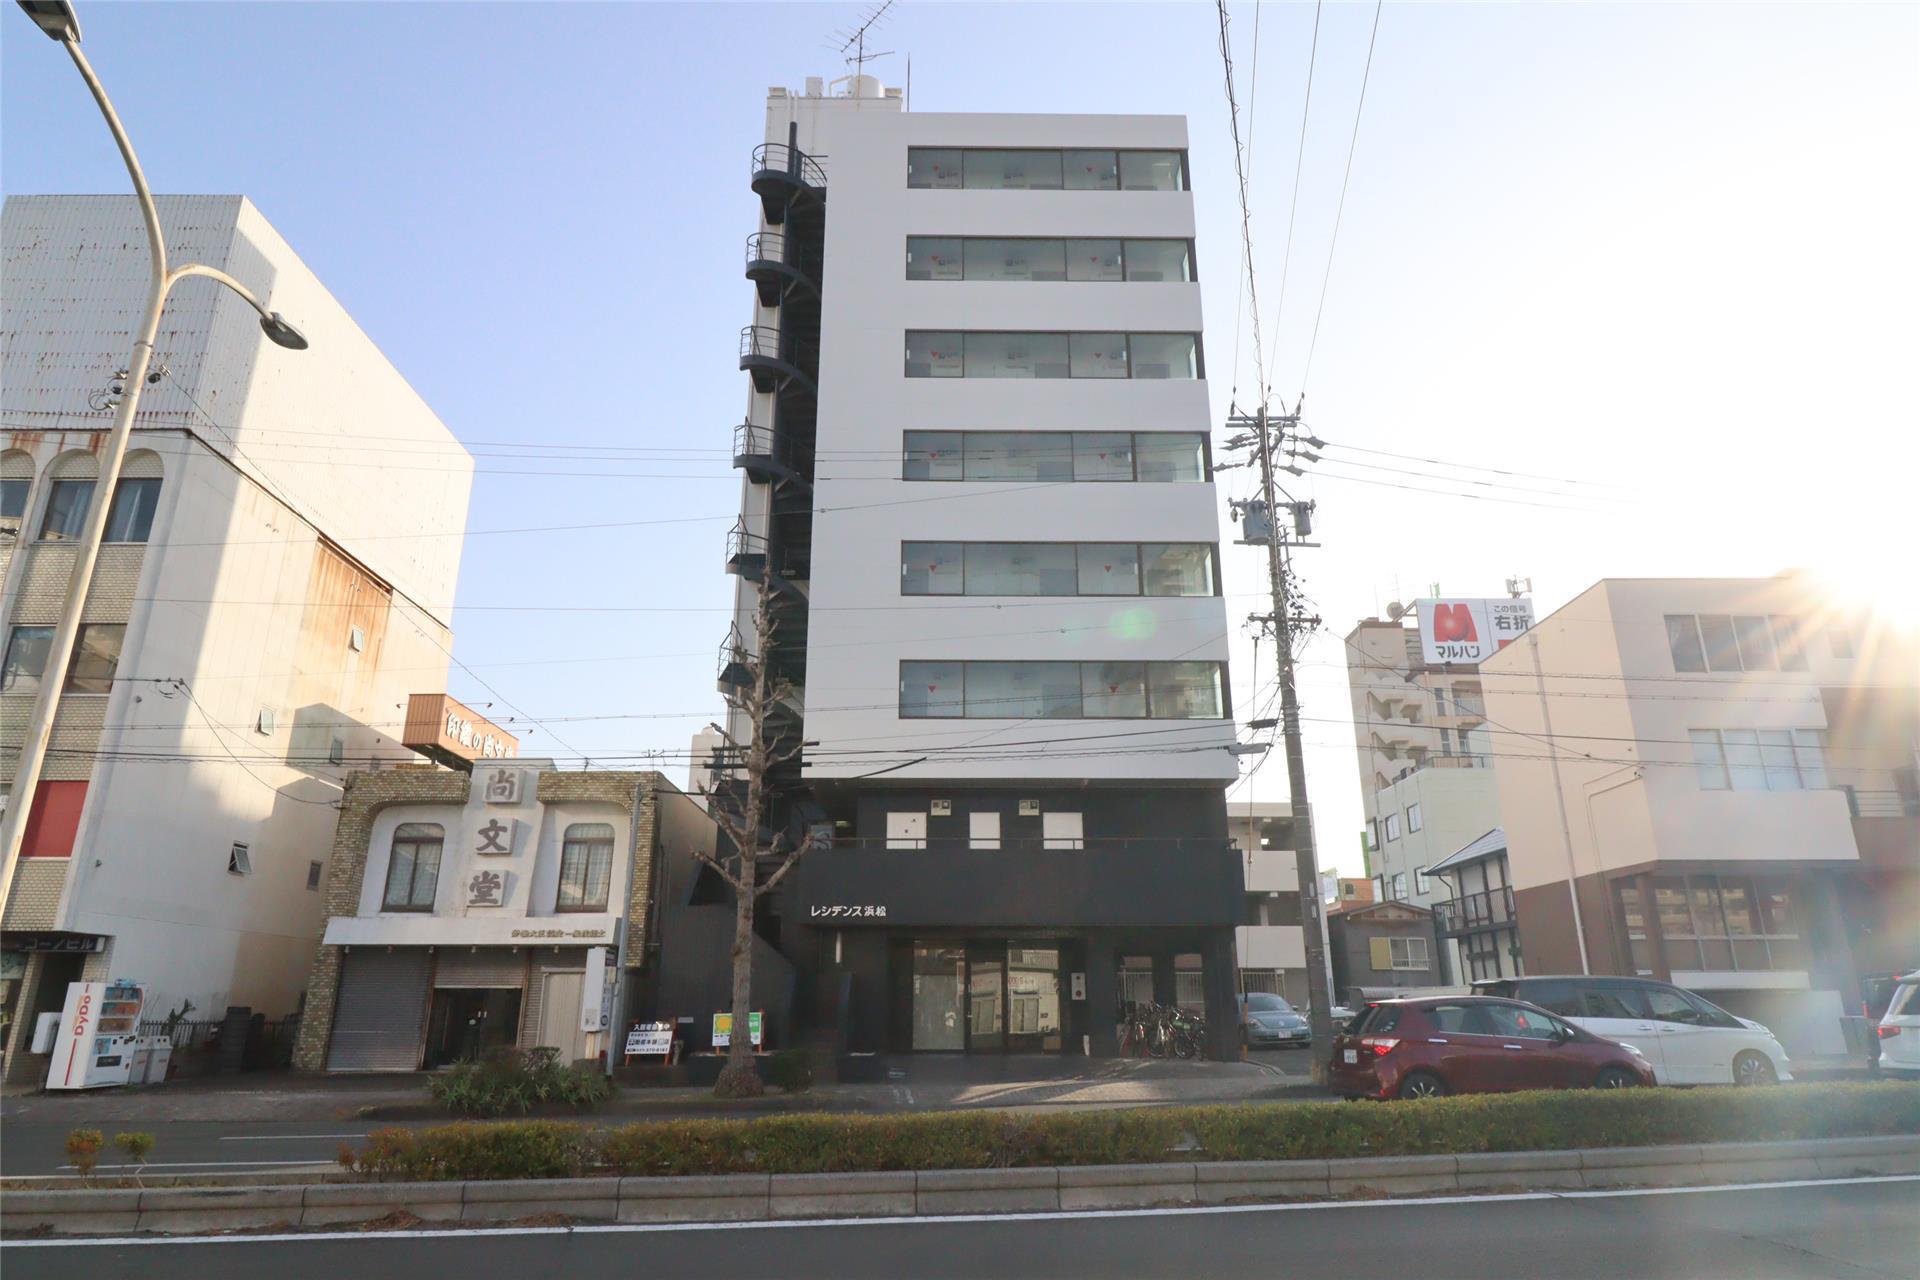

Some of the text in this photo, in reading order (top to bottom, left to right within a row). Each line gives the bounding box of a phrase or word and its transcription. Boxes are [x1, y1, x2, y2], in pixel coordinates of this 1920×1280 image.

[1495, 615, 1530, 631] 右折
[1436, 646, 1480, 659] マルハン
[469, 769, 516, 904] 尚文堂
[74, 995, 91, 1036] DyDo
